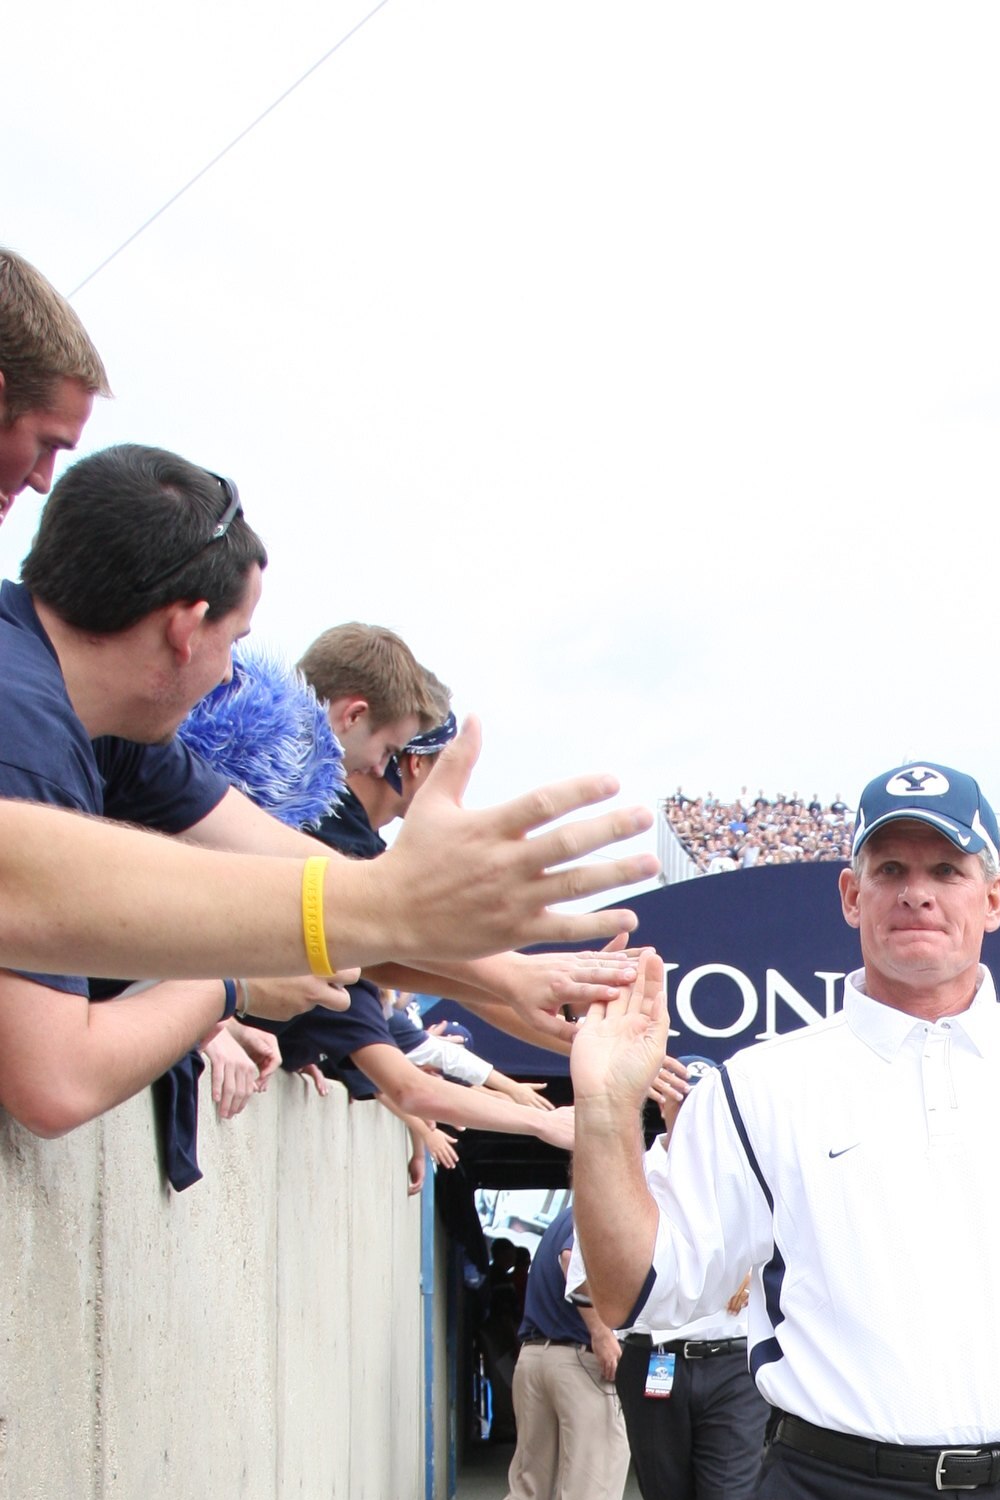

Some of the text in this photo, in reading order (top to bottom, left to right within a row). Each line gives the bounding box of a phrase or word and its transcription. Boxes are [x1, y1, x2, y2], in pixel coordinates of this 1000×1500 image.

[895, 770, 938, 791] Y
[307, 866, 321, 954] LIVESTRONG
[692, 1064, 707, 1074] Y
